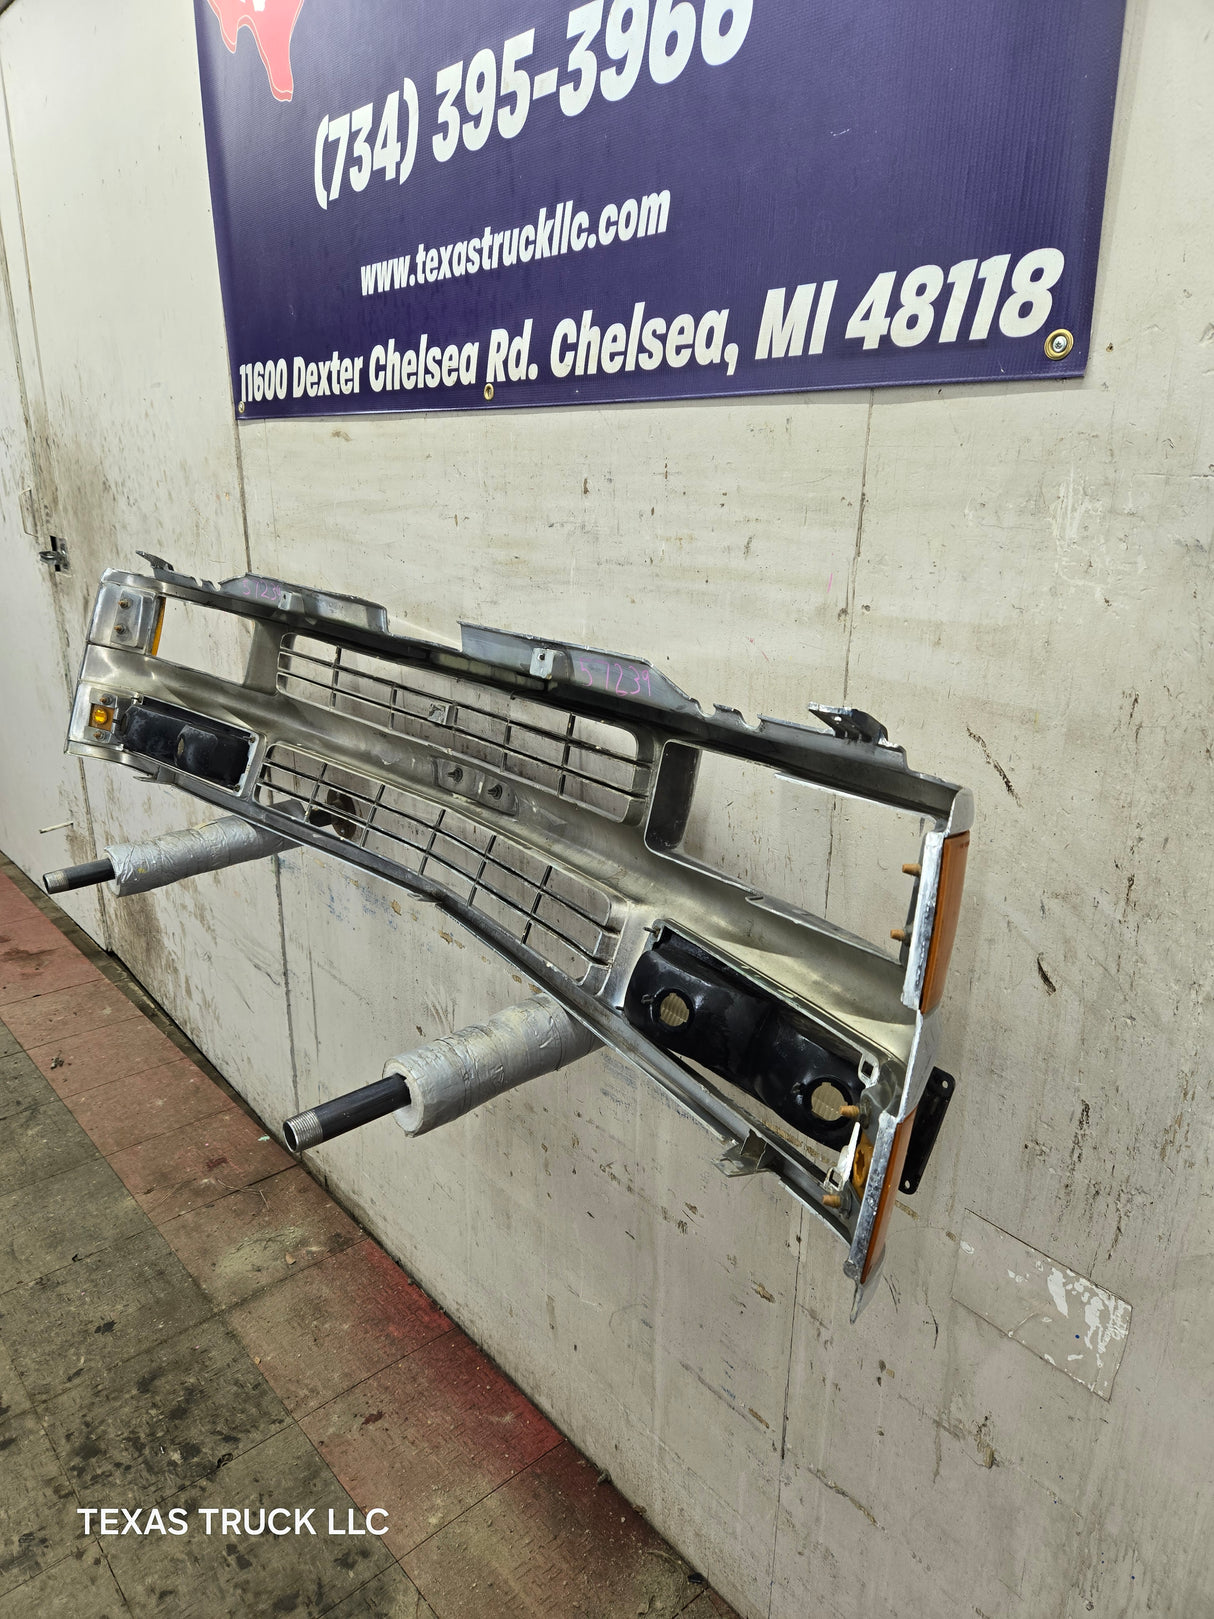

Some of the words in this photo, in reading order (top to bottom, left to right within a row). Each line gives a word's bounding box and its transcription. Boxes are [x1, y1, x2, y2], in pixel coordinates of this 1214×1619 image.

[314, 77, 419, 210] (734)
[360, 189, 671, 297] www.texastruckllc.com
[239, 358, 287, 402] 11600
[292, 350, 363, 397] Dexter
[368, 333, 480, 392] Chelsea
[485, 318, 538, 384] Rd.
[550, 301, 740, 378] Chelsea,
[754, 280, 839, 361] MI
[845, 247, 1065, 351] 48118
[579, 657, 652, 697] 57239
